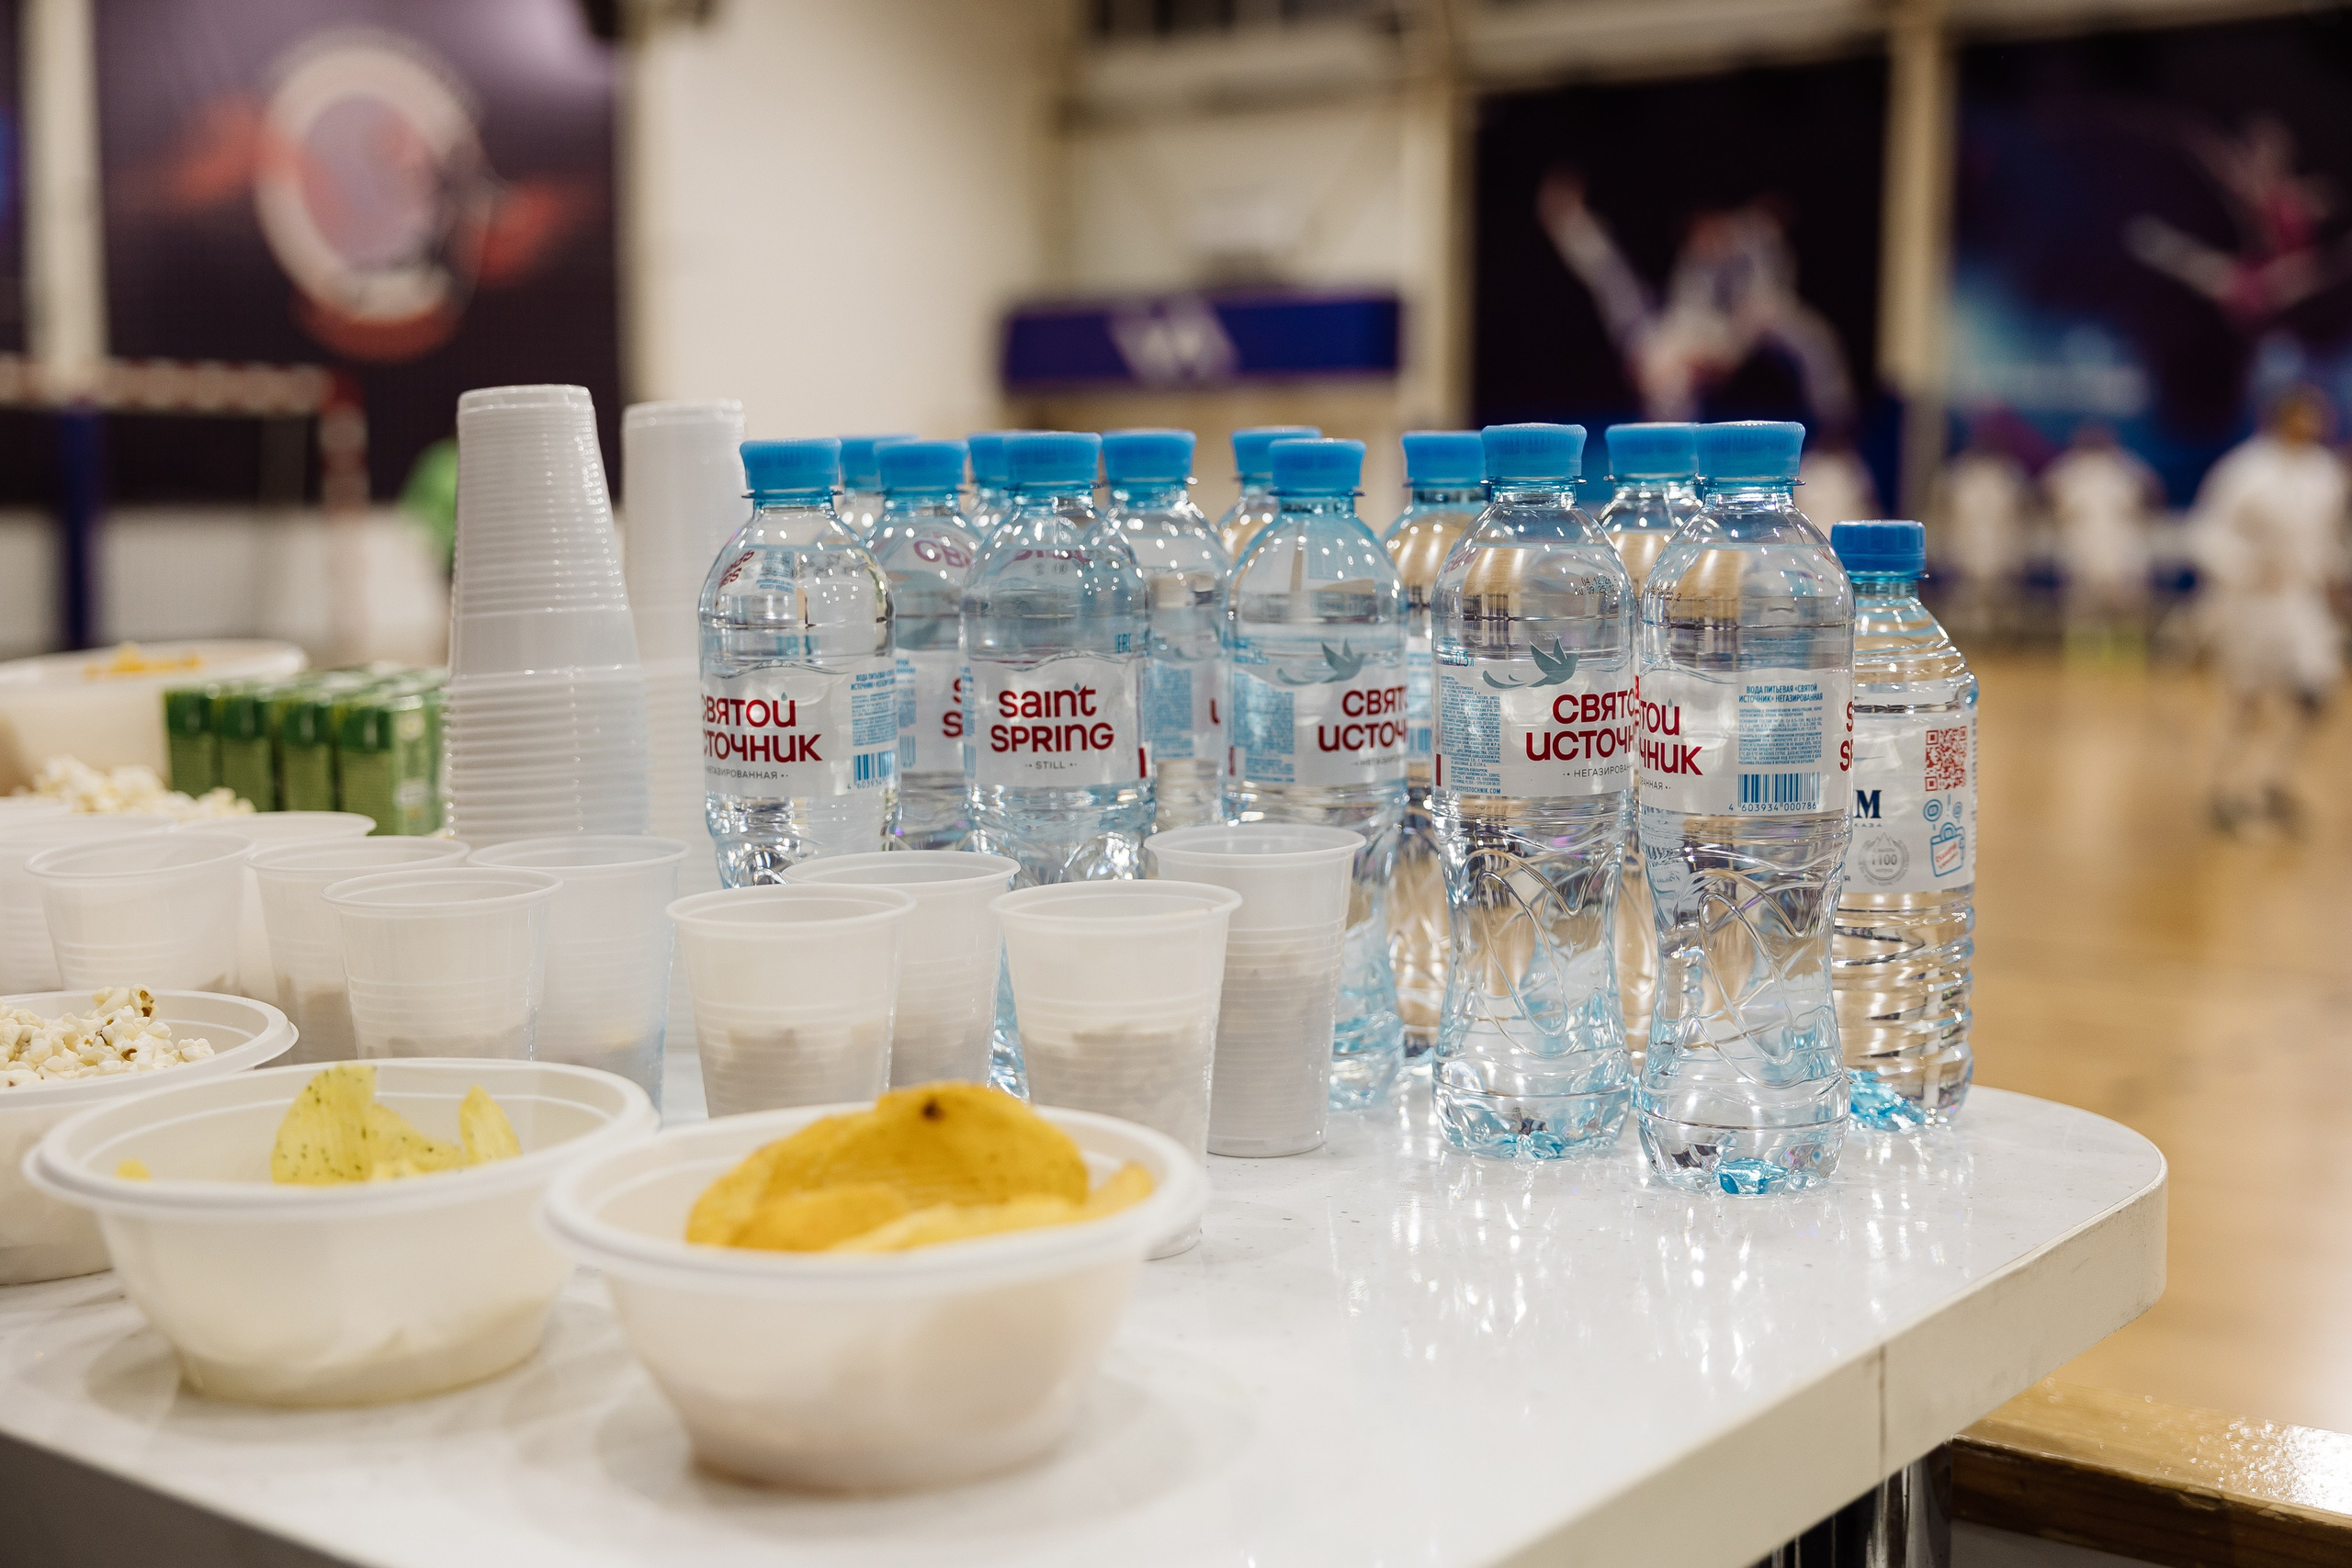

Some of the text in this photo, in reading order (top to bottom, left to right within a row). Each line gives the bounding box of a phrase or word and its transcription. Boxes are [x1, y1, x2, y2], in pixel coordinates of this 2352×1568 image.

[1746, 685, 1763, 694] ВОДА
[1764, 684, 1793, 694] ПИТЬЕВАЯ
[1341, 684, 1408, 717] СВЯТ
[1035, 761, 1066, 770] STILL
[1741, 804, 1779, 812] 603934
[1783, 801, 1817, 812] 000786
